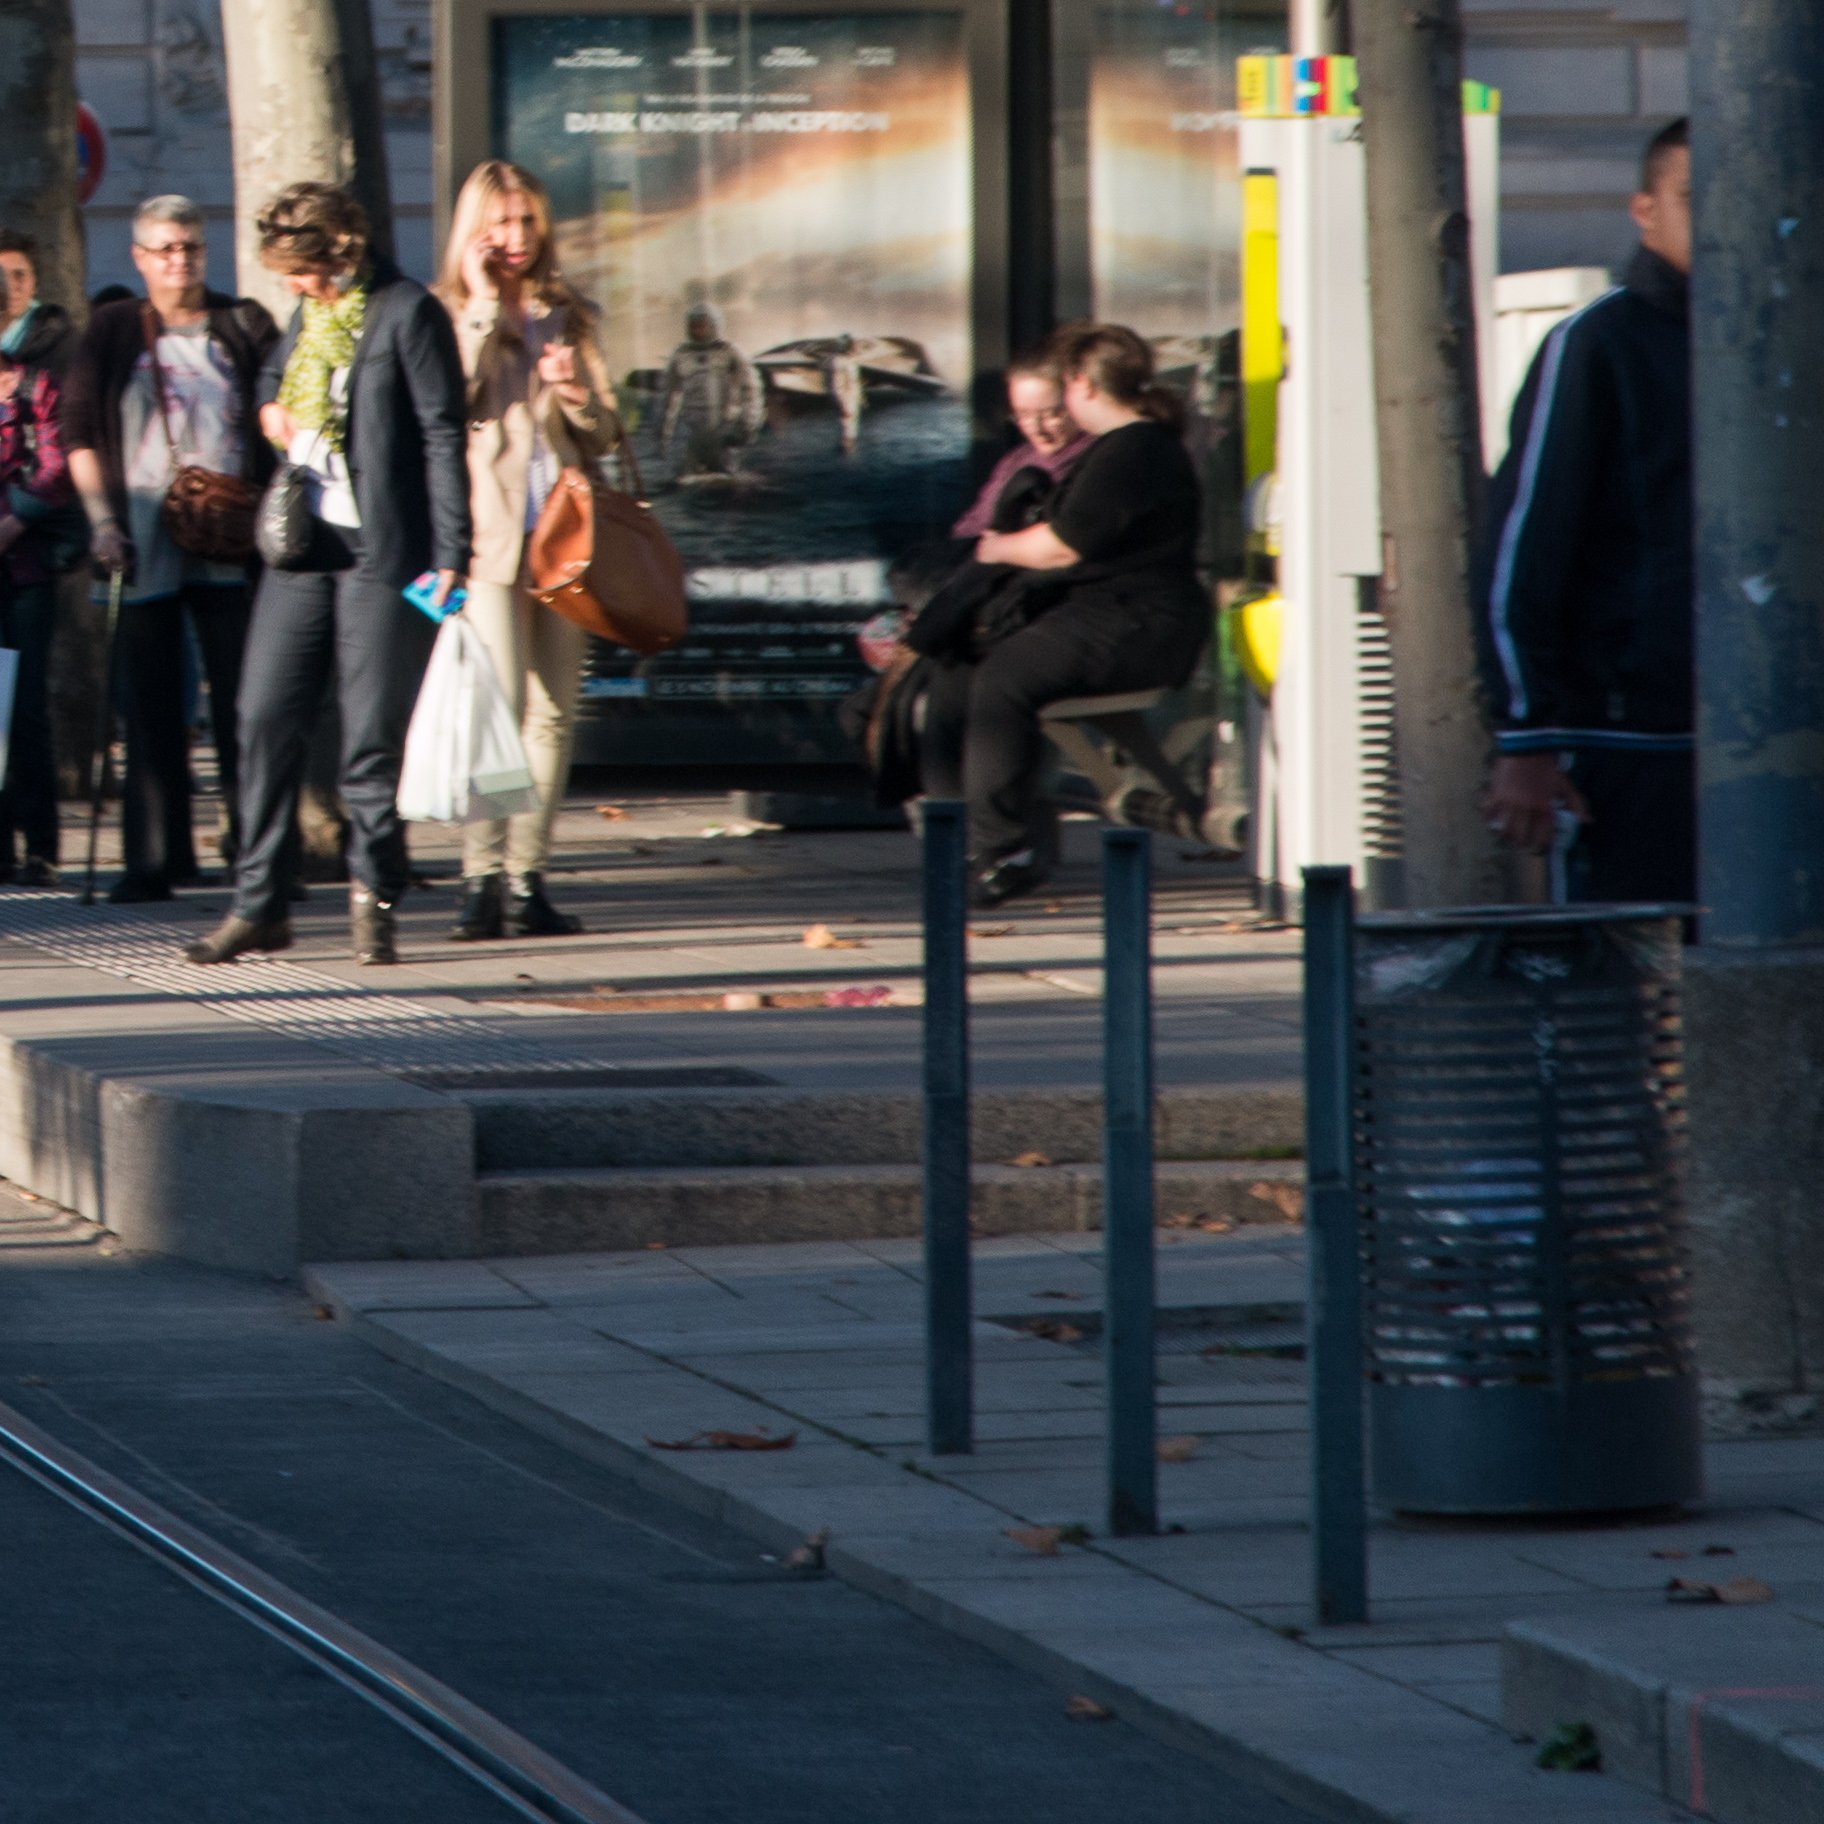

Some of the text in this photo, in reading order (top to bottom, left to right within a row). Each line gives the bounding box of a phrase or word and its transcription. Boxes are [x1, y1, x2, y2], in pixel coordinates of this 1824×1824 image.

[564, 111, 637, 133] DARK
[639, 111, 741, 133] KNIGHT
[754, 110, 891, 133] INCEPTION
